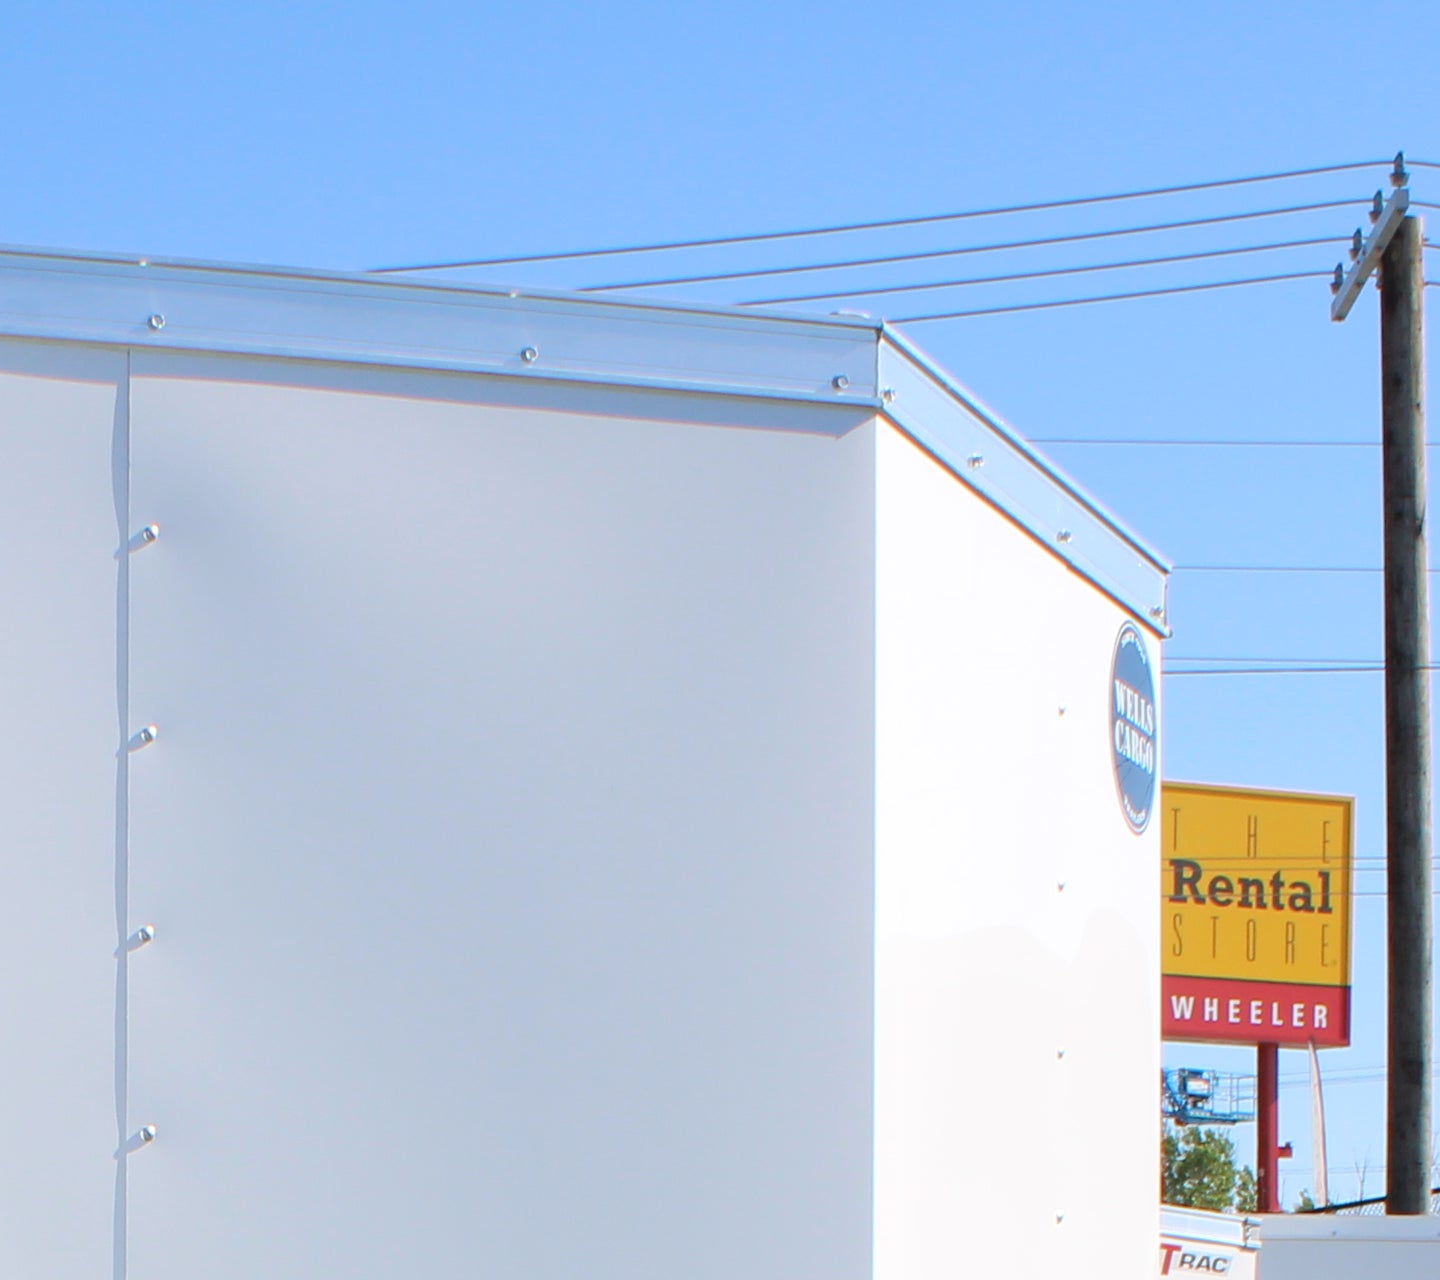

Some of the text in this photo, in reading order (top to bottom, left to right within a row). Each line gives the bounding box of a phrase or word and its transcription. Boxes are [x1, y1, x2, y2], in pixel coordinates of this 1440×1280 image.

[1114, 678, 1153, 736] WELLS
[1114, 718, 1154, 775] CARGO
[1171, 808, 1331, 863] THE
[1168, 857, 1333, 914] Rental
[1170, 994, 1328, 1029] WHEELER
